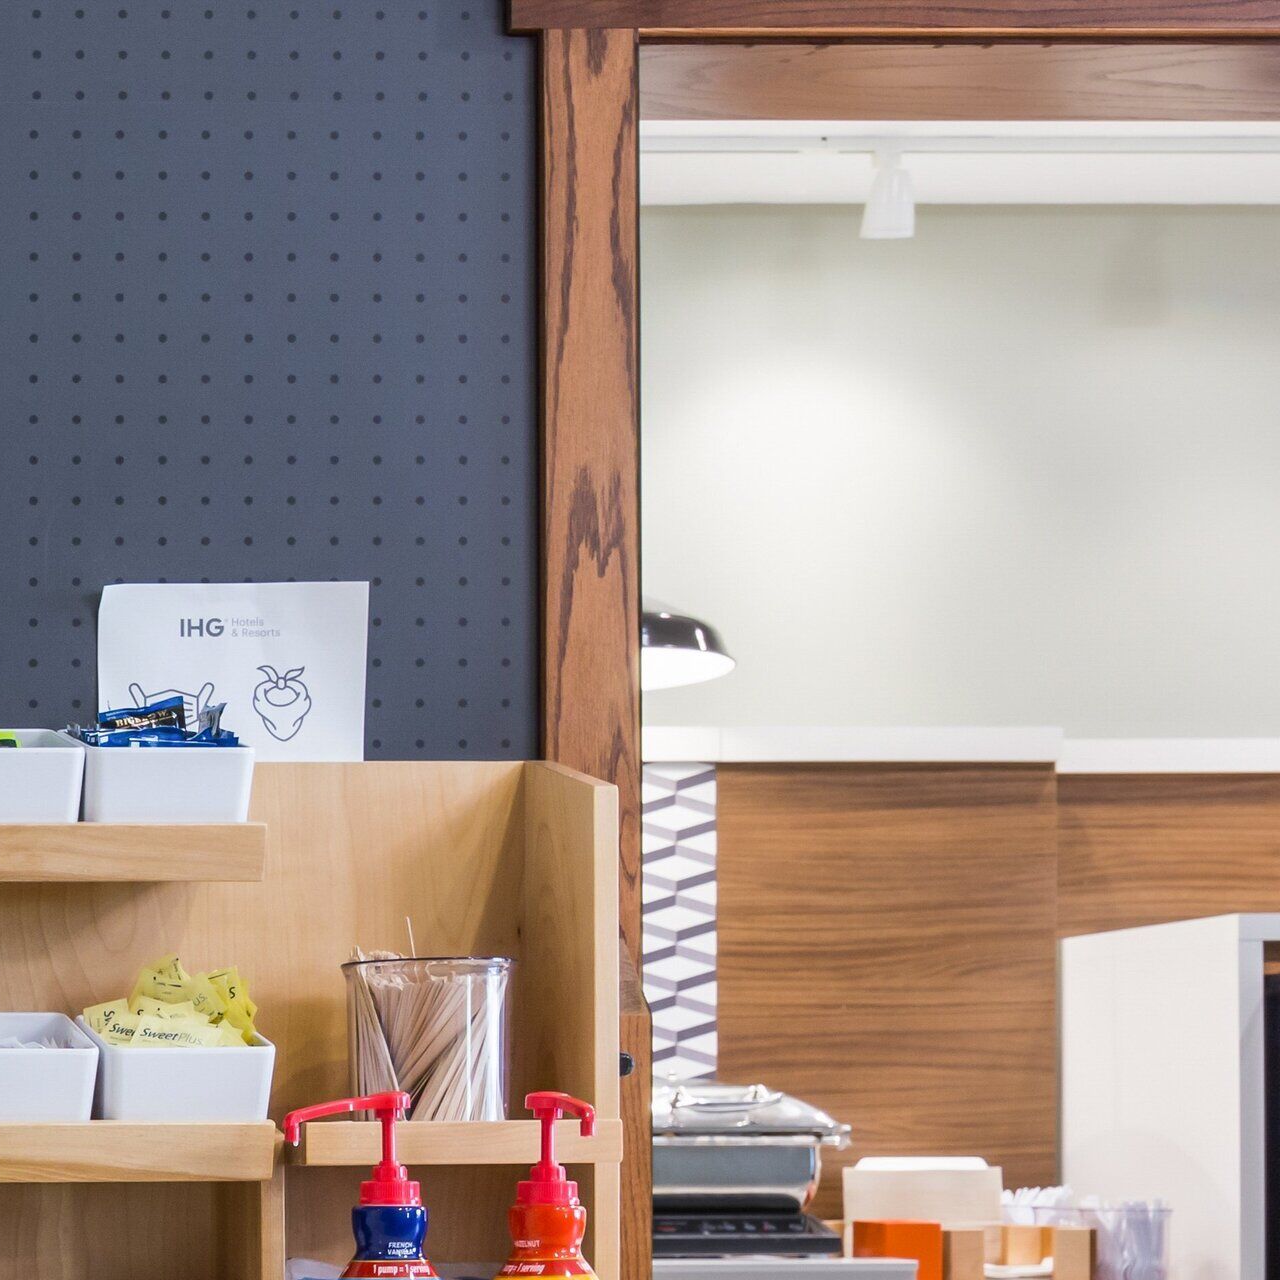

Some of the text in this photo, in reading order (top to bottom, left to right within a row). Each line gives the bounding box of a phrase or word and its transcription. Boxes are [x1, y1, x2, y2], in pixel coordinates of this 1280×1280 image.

[180, 617, 225, 637] IHG
[231, 616, 264, 627] Hotels
[231, 628, 281, 637] & Resorts
